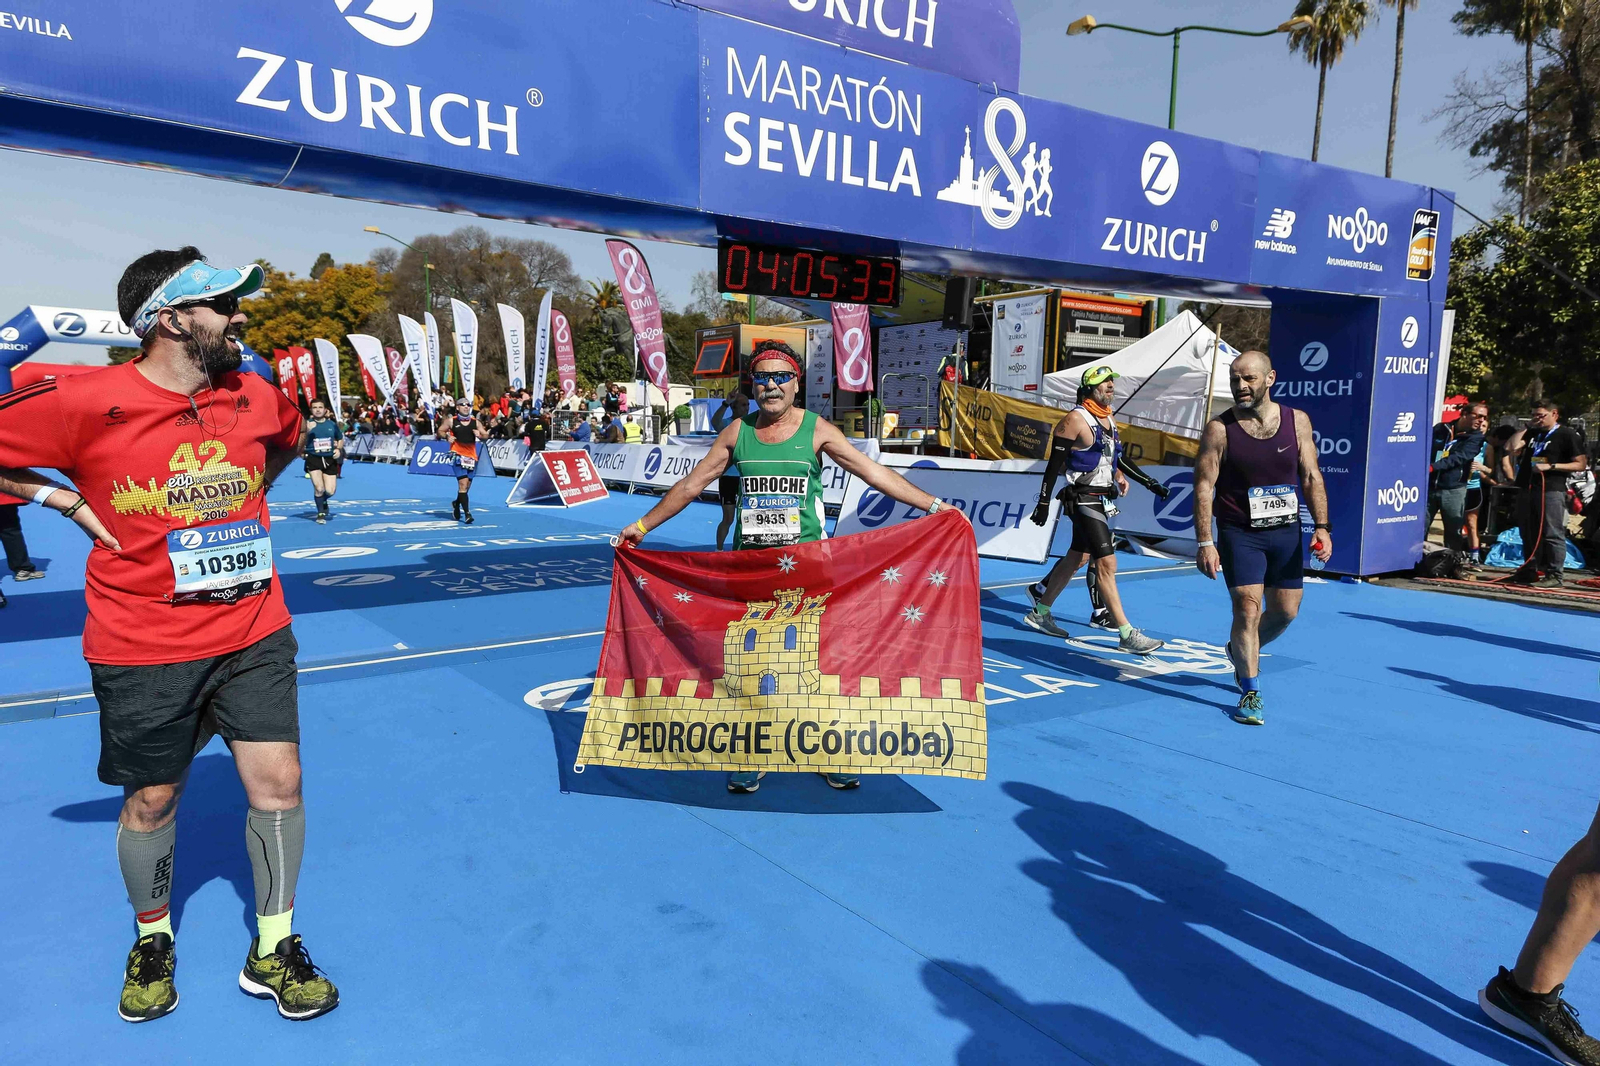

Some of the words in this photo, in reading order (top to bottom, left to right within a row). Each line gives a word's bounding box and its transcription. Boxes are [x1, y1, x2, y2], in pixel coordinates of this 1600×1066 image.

[236, 46, 520, 156] ZURICH
[727, 46, 922, 137] MARATÓN
[724, 111, 922, 198] SEVILLA
[1102, 218, 1207, 263] ZURICH
[1255, 240, 1270, 250] new
[1270, 240, 1297, 254] balance
[1410, 255, 1424, 265] GOLD
[724, 244, 896, 303] 04:05:33
[1384, 357, 1429, 375] ZURICH
[1274, 379, 1353, 398] ZURICH
[168, 440, 230, 472] 42
[167, 480, 248, 506] MADRID
[1263, 500, 1286, 510] 7495
[202, 510, 228, 521] 2016
[206, 525, 259, 543] ZURICH
[196, 550, 257, 576] 10398
[407, 558, 608, 578] ZURICH
[204, 579, 231, 589] JAVIER
[618, 721, 772, 754] PEDROCHE
[785, 718, 954, 767] (Córdoba)
[152, 844, 173, 899] SURAL
